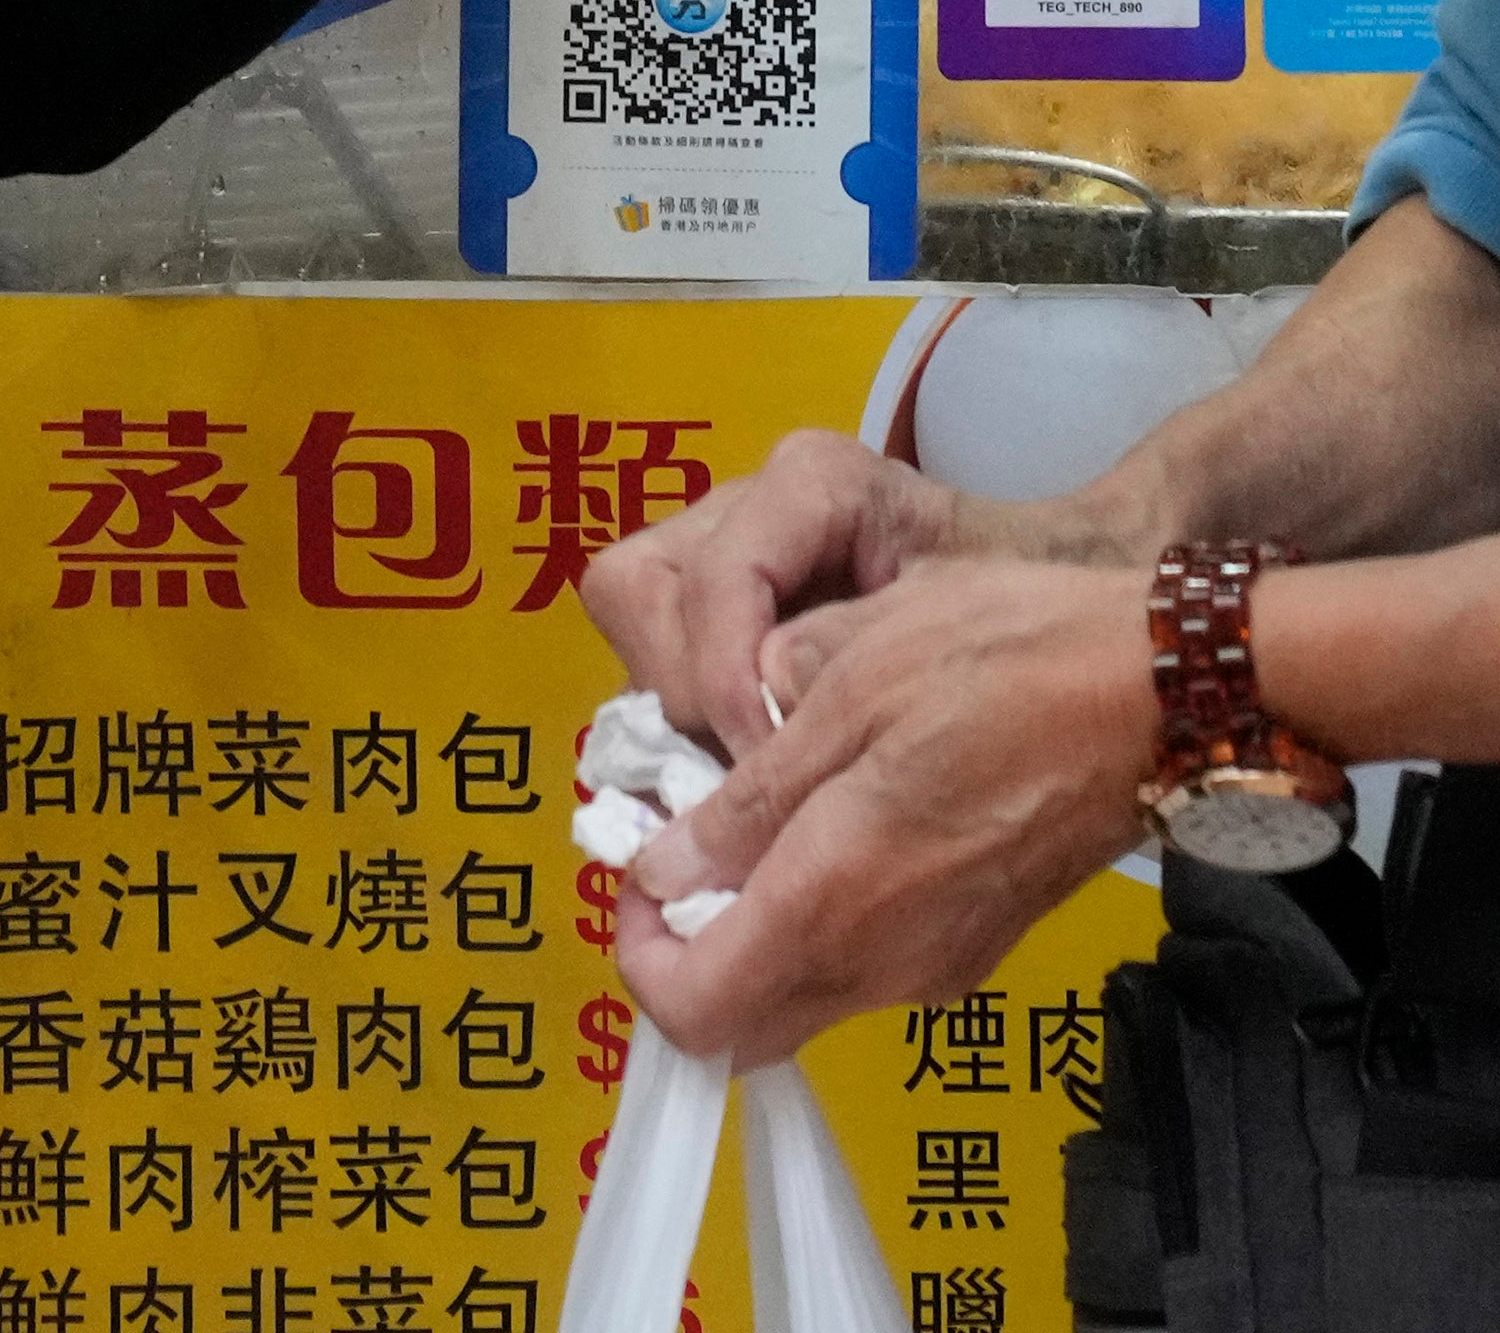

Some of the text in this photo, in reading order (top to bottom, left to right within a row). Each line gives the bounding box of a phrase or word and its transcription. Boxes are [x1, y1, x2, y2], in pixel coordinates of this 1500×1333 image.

[658, 195, 761, 217] 掃碼領優惠
[41, 408, 713, 613] 蒸包類
